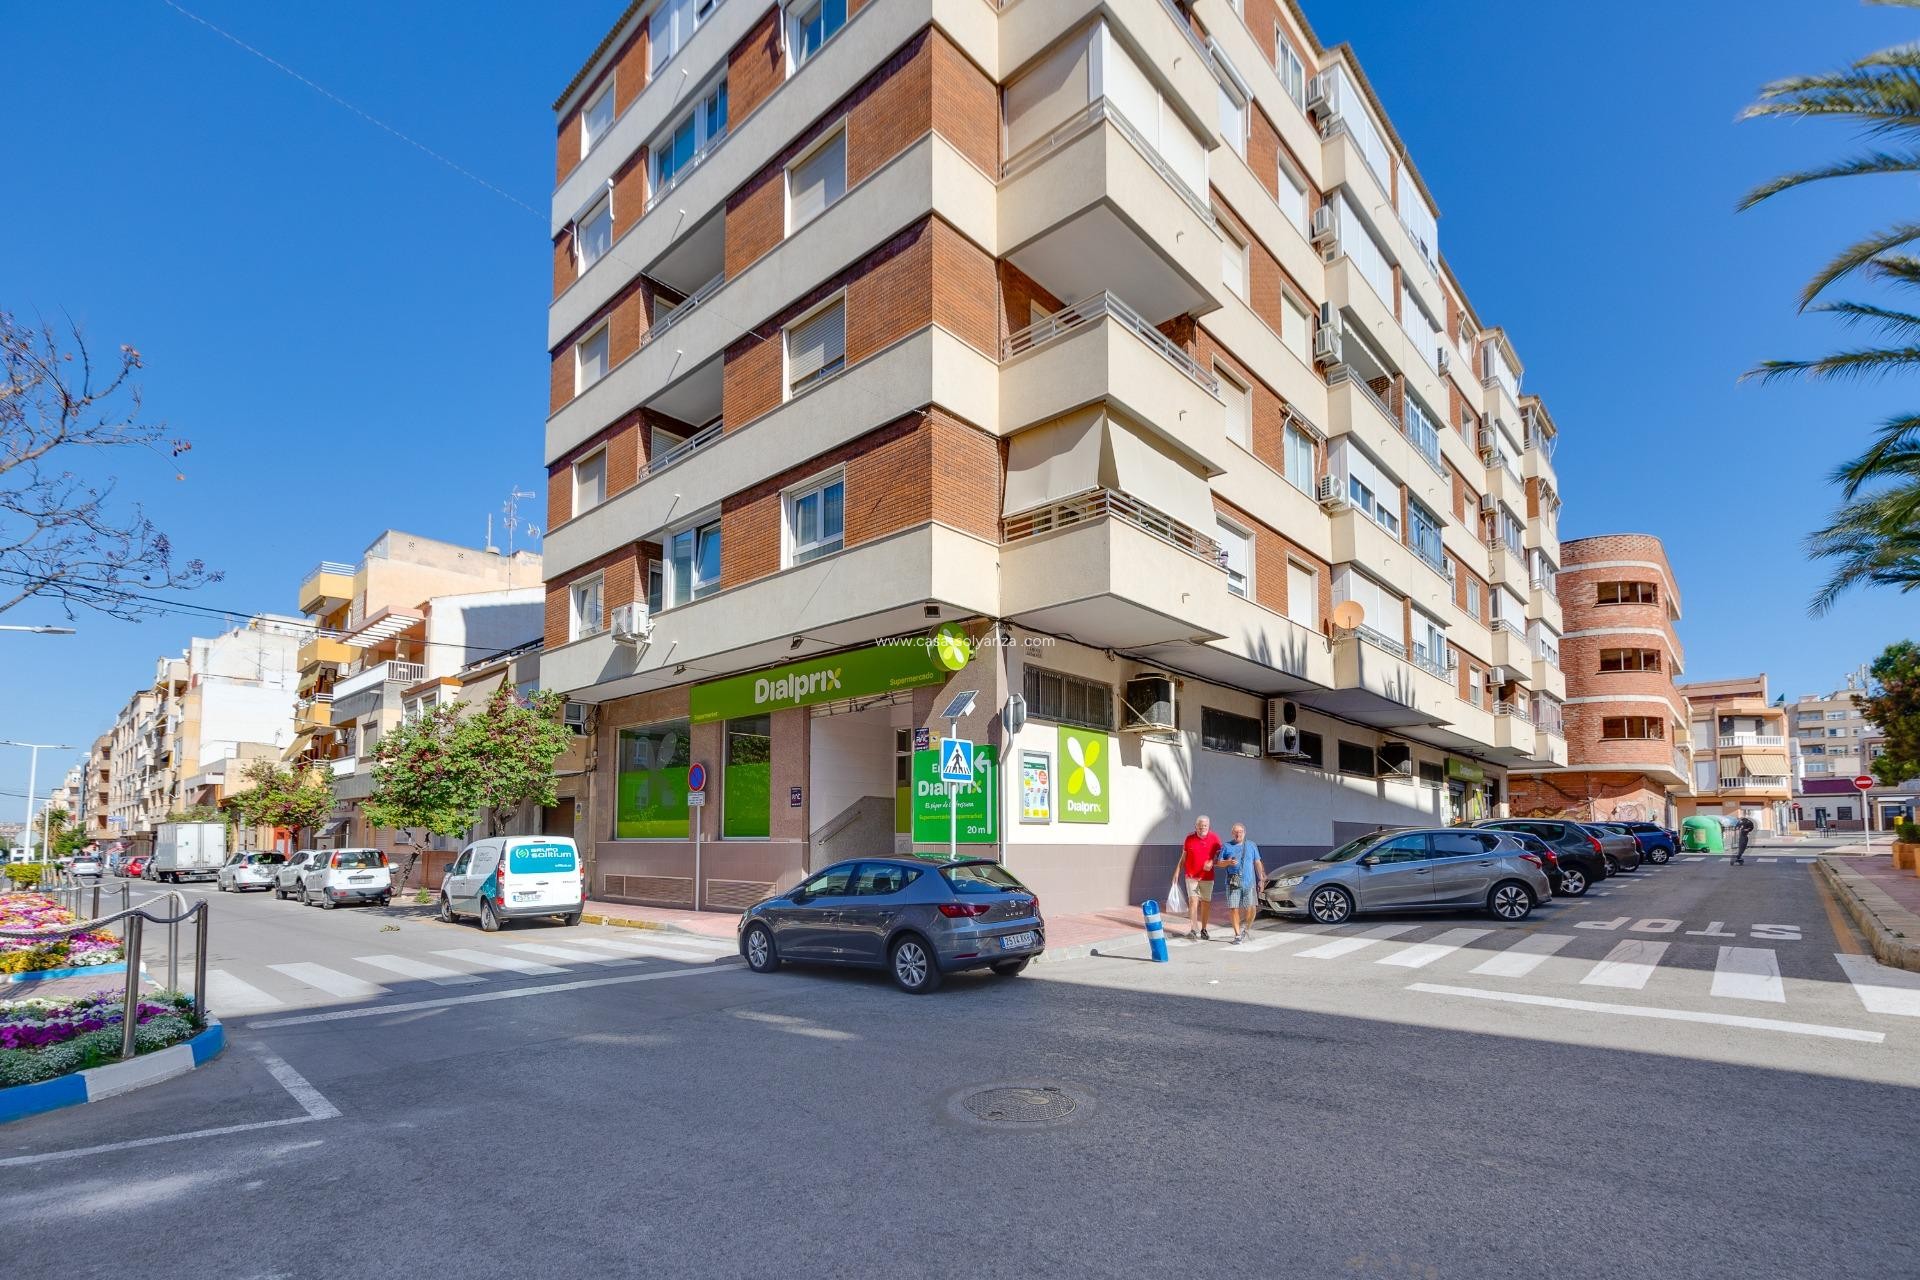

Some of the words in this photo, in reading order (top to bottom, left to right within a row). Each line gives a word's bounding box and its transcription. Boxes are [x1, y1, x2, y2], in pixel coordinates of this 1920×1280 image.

[754, 667, 843, 704] Dialprix
[889, 671, 934, 687] Supermercado
[1067, 799, 1102, 815] Dialprix
[967, 825, 976, 834] 20
[1572, 916, 1802, 940] STOP
